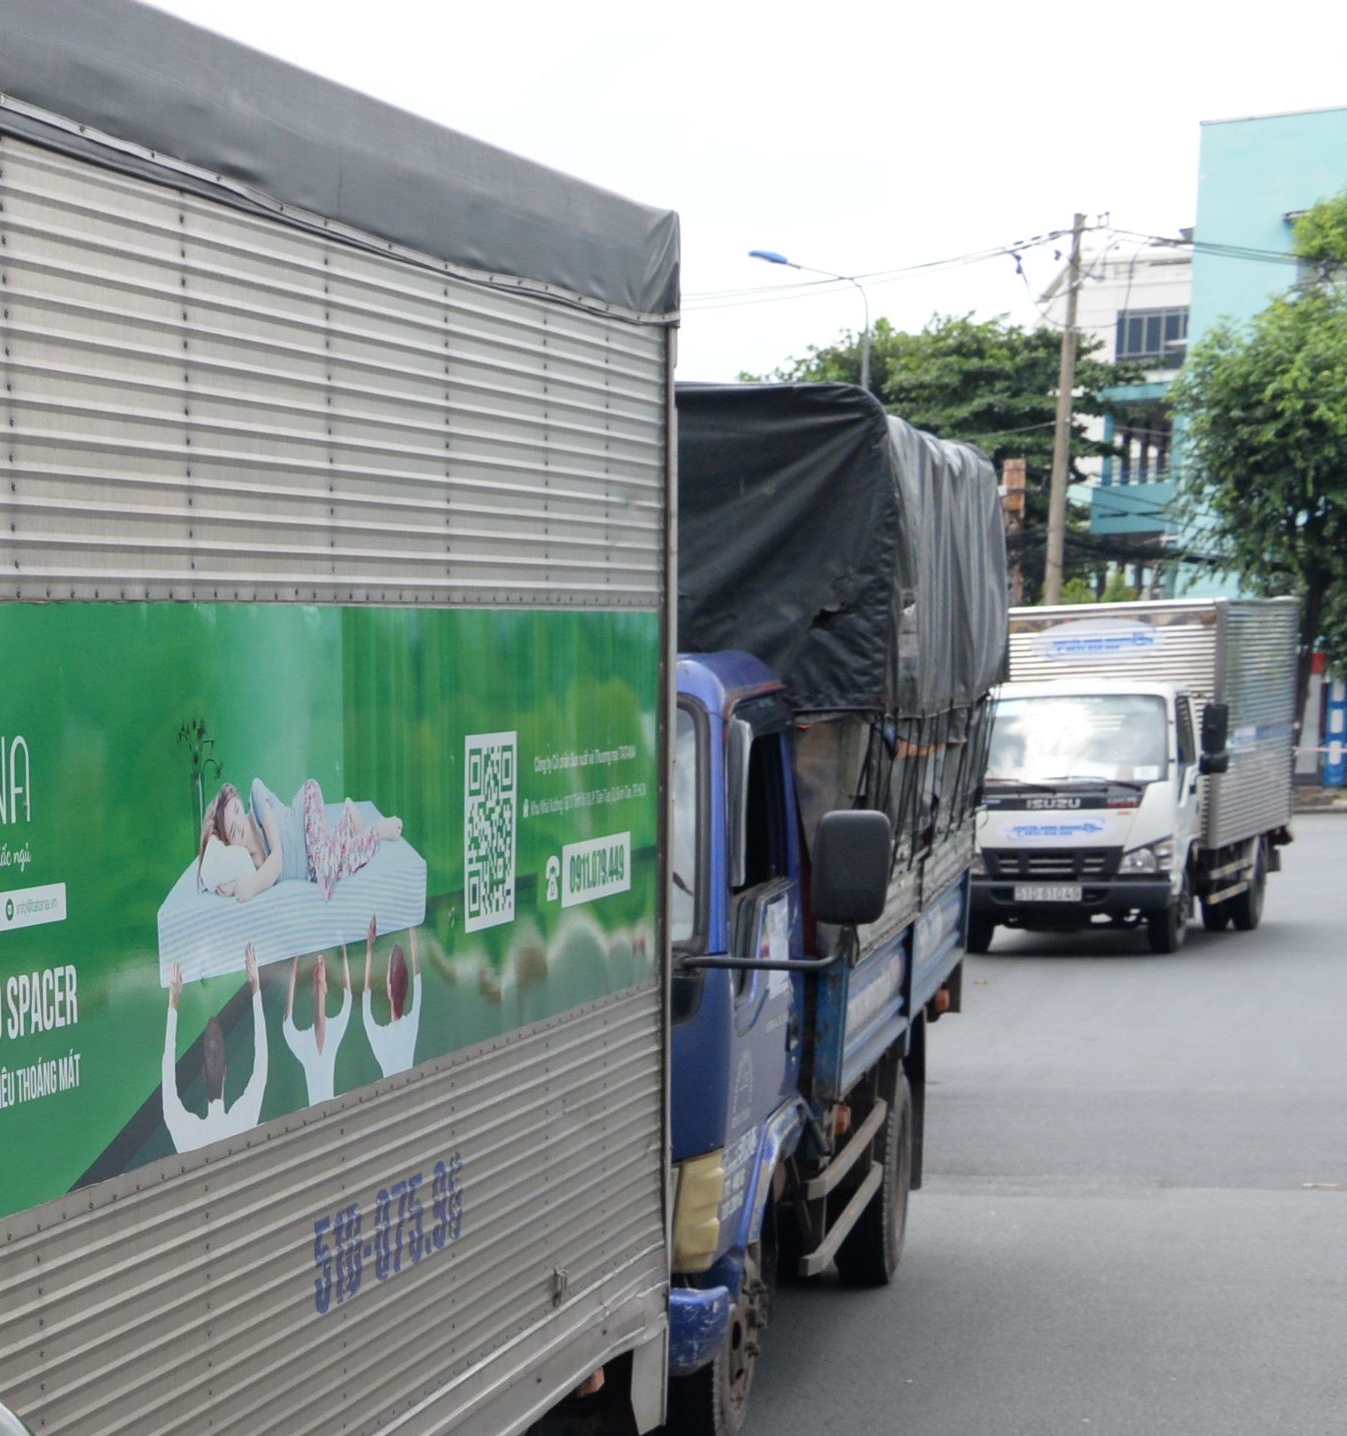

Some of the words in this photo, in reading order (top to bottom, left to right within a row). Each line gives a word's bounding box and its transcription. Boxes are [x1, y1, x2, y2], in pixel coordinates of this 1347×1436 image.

[1027, 798, 1081, 809] ISUZU
[13, 842, 32, 872] ngủ
[6, 964, 78, 1040] SPACER
[16, 1056, 57, 1104] THOÁNG
[58, 1048, 81, 1092] MÁT
